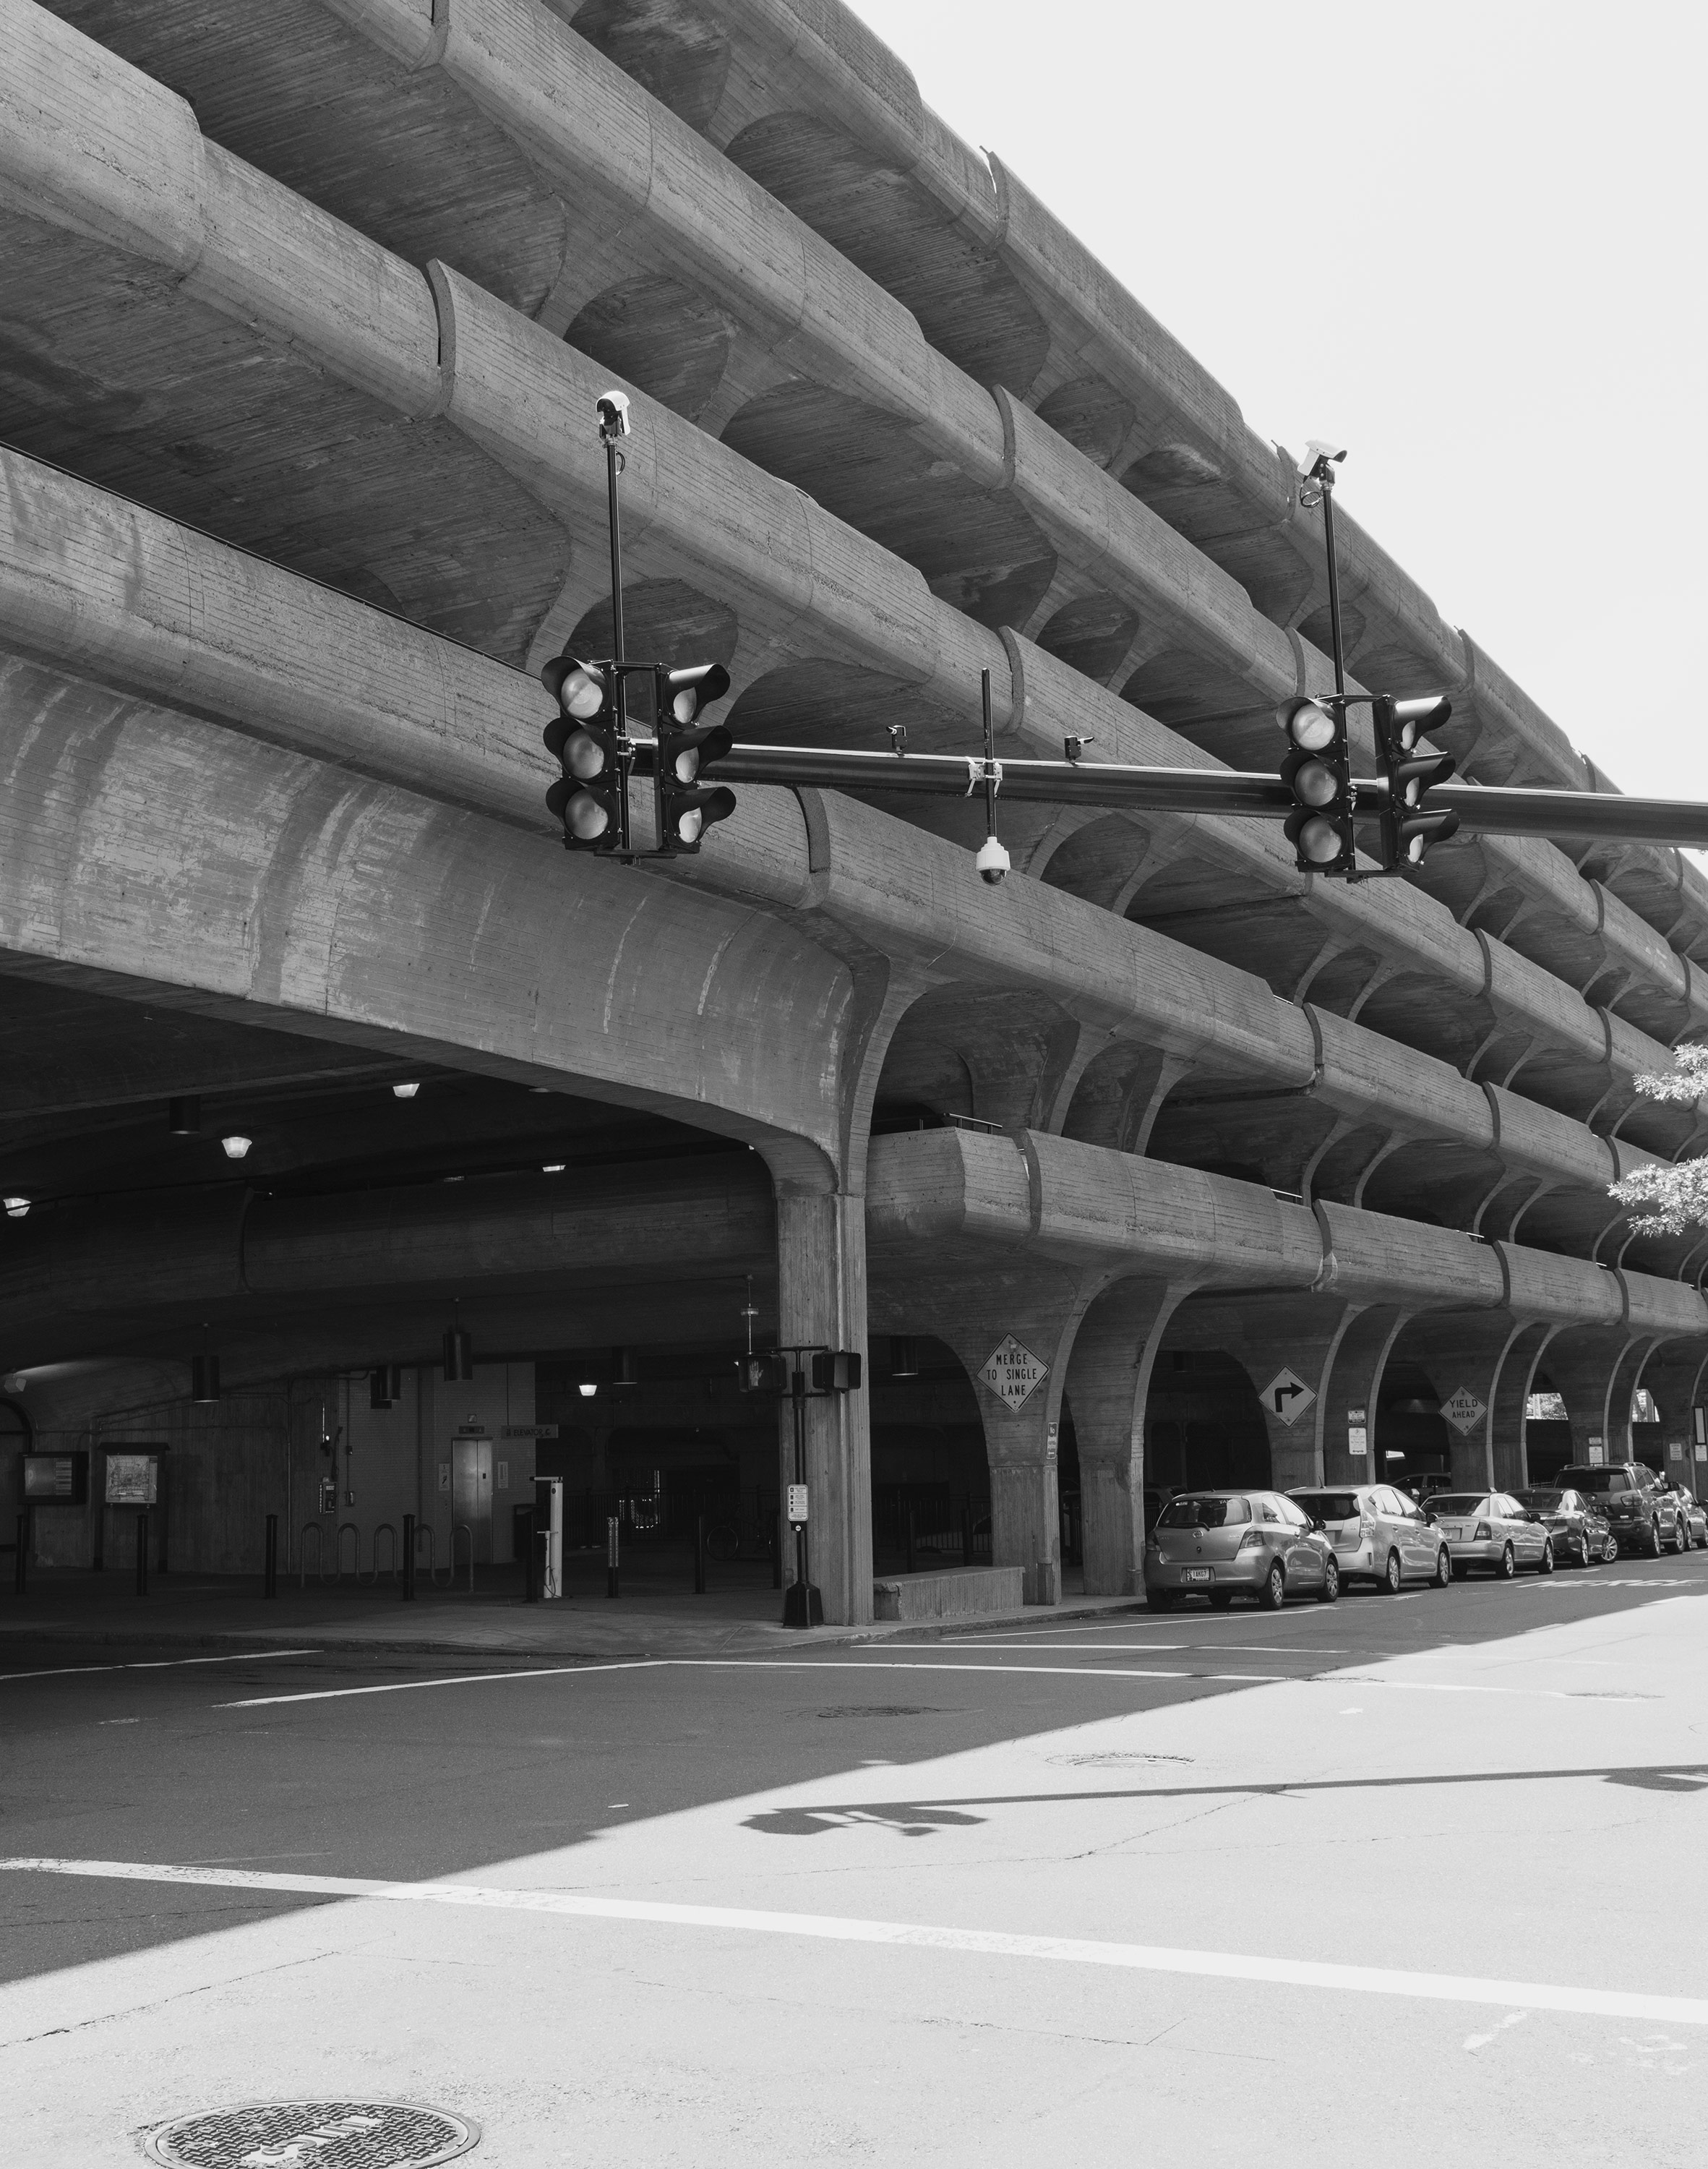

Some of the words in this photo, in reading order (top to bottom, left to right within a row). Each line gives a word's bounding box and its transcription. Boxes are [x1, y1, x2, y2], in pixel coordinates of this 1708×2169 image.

[996, 1353, 1028, 1365] MERGE
[987, 1369, 997, 1380] TO
[1006, 1368, 1037, 1380] SINGLE
[1001, 1385, 1026, 1396] LANE
[1449, 1398, 1478, 1408] YIELD
[1452, 1410, 1475, 1419] AHEAD
[513, 1428, 543, 1437] ELEVATOR
